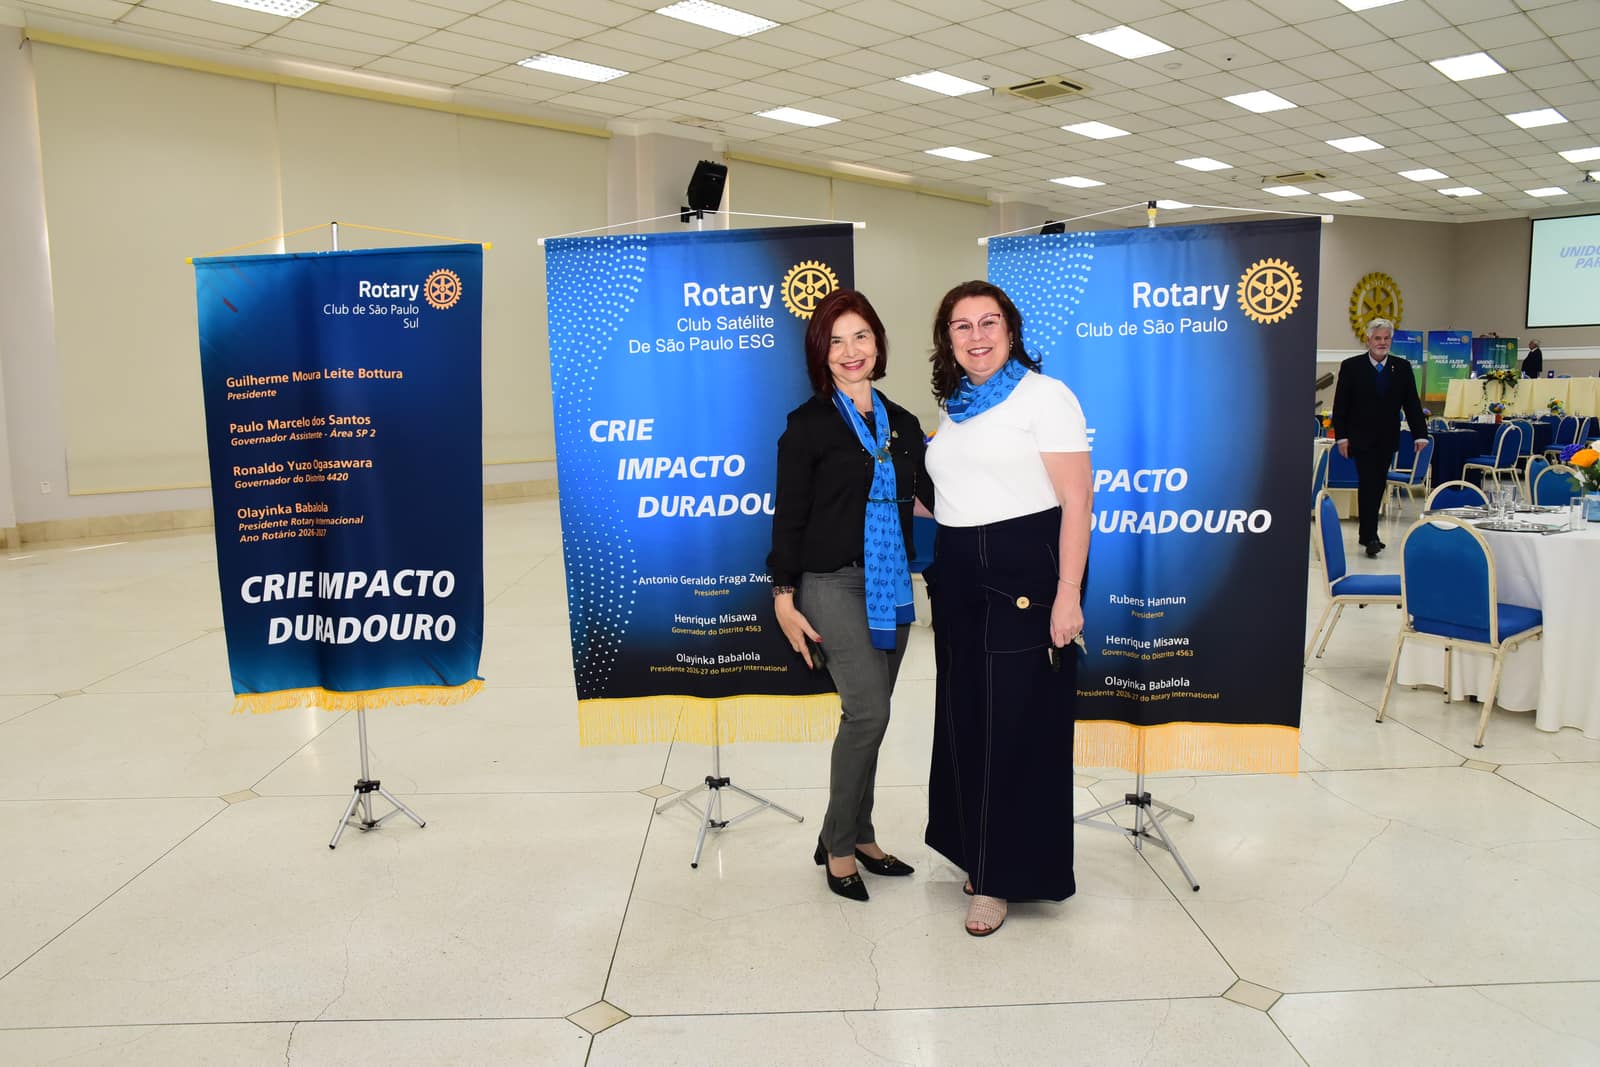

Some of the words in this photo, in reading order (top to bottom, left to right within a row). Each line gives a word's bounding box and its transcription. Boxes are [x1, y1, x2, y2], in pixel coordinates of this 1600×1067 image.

[358, 280, 420, 301] Rotary
[683, 282, 774, 309] Rotary
[1132, 282, 1230, 310] Rotary
[323, 304, 350, 315] Club
[353, 304, 365, 315] de
[368, 303, 388, 315] São
[390, 304, 420, 315] Paulo
[403, 318, 419, 328] Sul
[677, 316, 712, 332] Club
[716, 314, 774, 331] Satélite
[1076, 322, 1113, 338] Club
[1118, 321, 1138, 336] de
[1143, 318, 1175, 335] São
[1180, 317, 1228, 334] Paulo
[629, 338, 650, 354] De
[655, 336, 685, 353] São
[689, 335, 734, 352] Paulo
[738, 333, 775, 350] ESG
[226, 372, 289, 388] Guilherme
[292, 370, 321, 382] Moura
[324, 368, 354, 380] Leite
[358, 368, 403, 380] Bottura
[227, 389, 277, 400] Presidente
[230, 421, 264, 434] Paulo
[267, 417, 310, 430] Marcelo
[312, 416, 326, 426] dos
[328, 414, 371, 426] Santos
[589, 418, 654, 443] CRIE
[231, 434, 287, 446] Governador
[289, 431, 323, 441] Assistente
[329, 428, 353, 438] Área
[356, 429, 368, 438] SP
[370, 428, 376, 438] 2
[233, 462, 284, 476] Ronaldo
[288, 461, 312, 472] Yuzo
[313, 459, 372, 472] Ogasawara
[617, 454, 746, 481] IMPACTO
[234, 476, 290, 489] Governador
[293, 475, 304, 484] do
[326, 472, 349, 481] 4420
[237, 504, 292, 520] Olayinka
[296, 502, 328, 513] Babalola
[637, 492, 776, 518] DURADOU
[238, 518, 289, 532] Presidente
[290, 518, 314, 527] Rotary
[1091, 510, 1272, 534] URADOURO
[240, 534, 260, 543] Ano
[262, 530, 296, 541] Rotário
[240, 571, 314, 604] CRIE
[318, 569, 456, 600] IMPACTO
[638, 575, 678, 586] Antonio
[680, 575, 717, 586] Geraldo
[719, 574, 746, 586] Fraga
[749, 574, 774, 584] Zwic
[694, 588, 730, 597] Presidente
[1110, 594, 1144, 607] Rubens
[1147, 595, 1186, 607] Hannun
[674, 613, 717, 626] Henrique
[719, 614, 757, 624] Misawa
[1131, 610, 1164, 619] Presidente
[268, 614, 456, 645] DURADOURO
[672, 626, 706, 636] Governador
[708, 628, 718, 636] do
[719, 626, 744, 634] Distrito
[745, 625, 762, 633] 4563
[1106, 635, 1151, 649] Henrique
[1153, 635, 1190, 648] Misawa
[676, 653, 715, 666] Olayinka
[718, 652, 760, 664] Babalola
[1102, 648, 1140, 659] Governador
[1141, 652, 1150, 660] do
[1152, 650, 1174, 660] Distrito
[744, 664, 788, 672] International
[1104, 676, 1146, 690] Olayinka
[1149, 677, 1190, 690] Babalola
[1076, 689, 1114, 697] Presidente
[1150, 692, 1170, 700] Rotary
[1172, 690, 1220, 700] International
